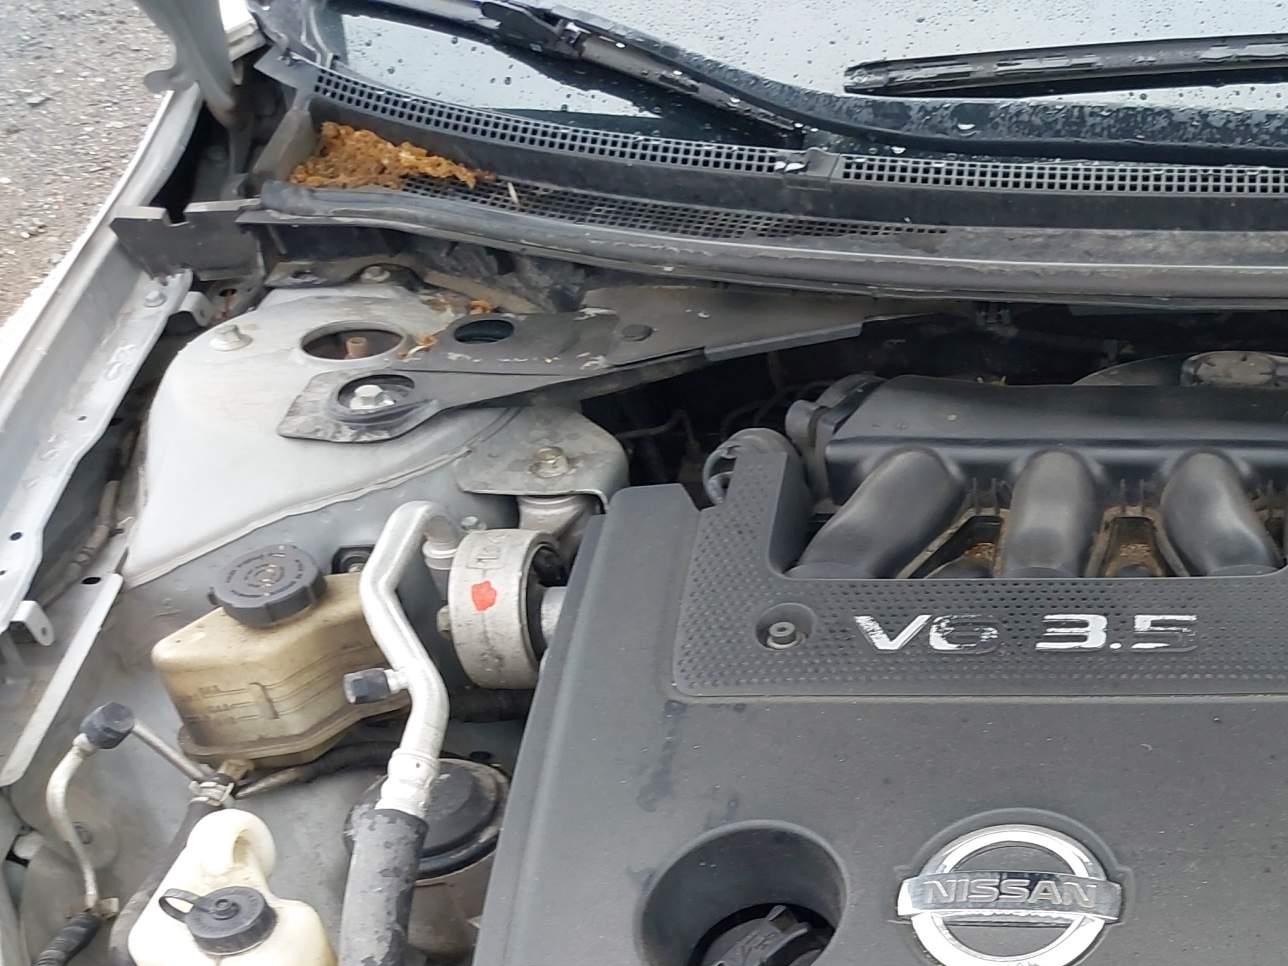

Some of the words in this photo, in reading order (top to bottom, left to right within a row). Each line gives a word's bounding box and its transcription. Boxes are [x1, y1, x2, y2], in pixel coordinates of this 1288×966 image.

[854, 613, 999, 652] V6
[1035, 613, 1198, 652] 3.5
[923, 878, 1097, 908] NISSAN
